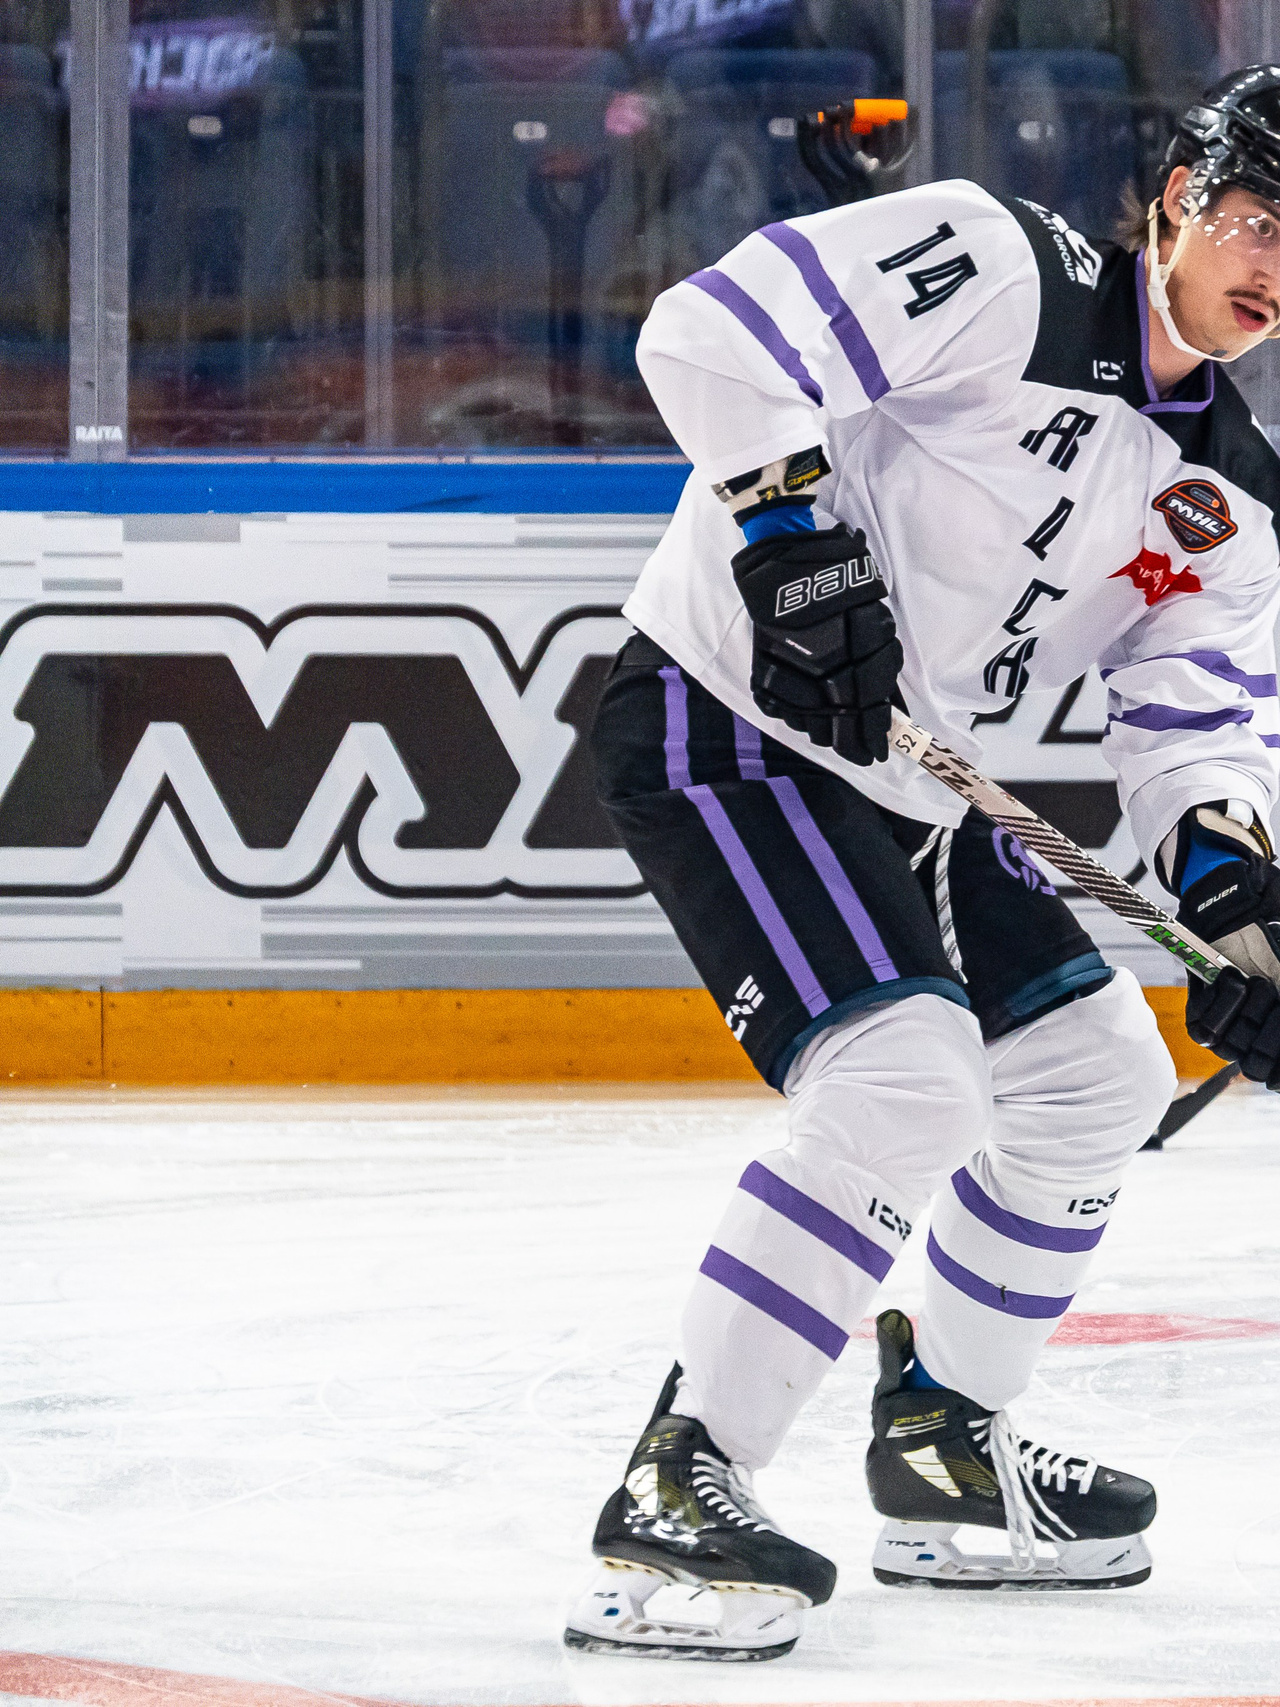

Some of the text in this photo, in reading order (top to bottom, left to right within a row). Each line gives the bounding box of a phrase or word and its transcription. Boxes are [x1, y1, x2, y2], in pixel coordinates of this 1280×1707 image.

[875, 220, 979, 320] 14
[894, 733, 918, 755] 52
[886, 1540, 928, 1548] TRUE
